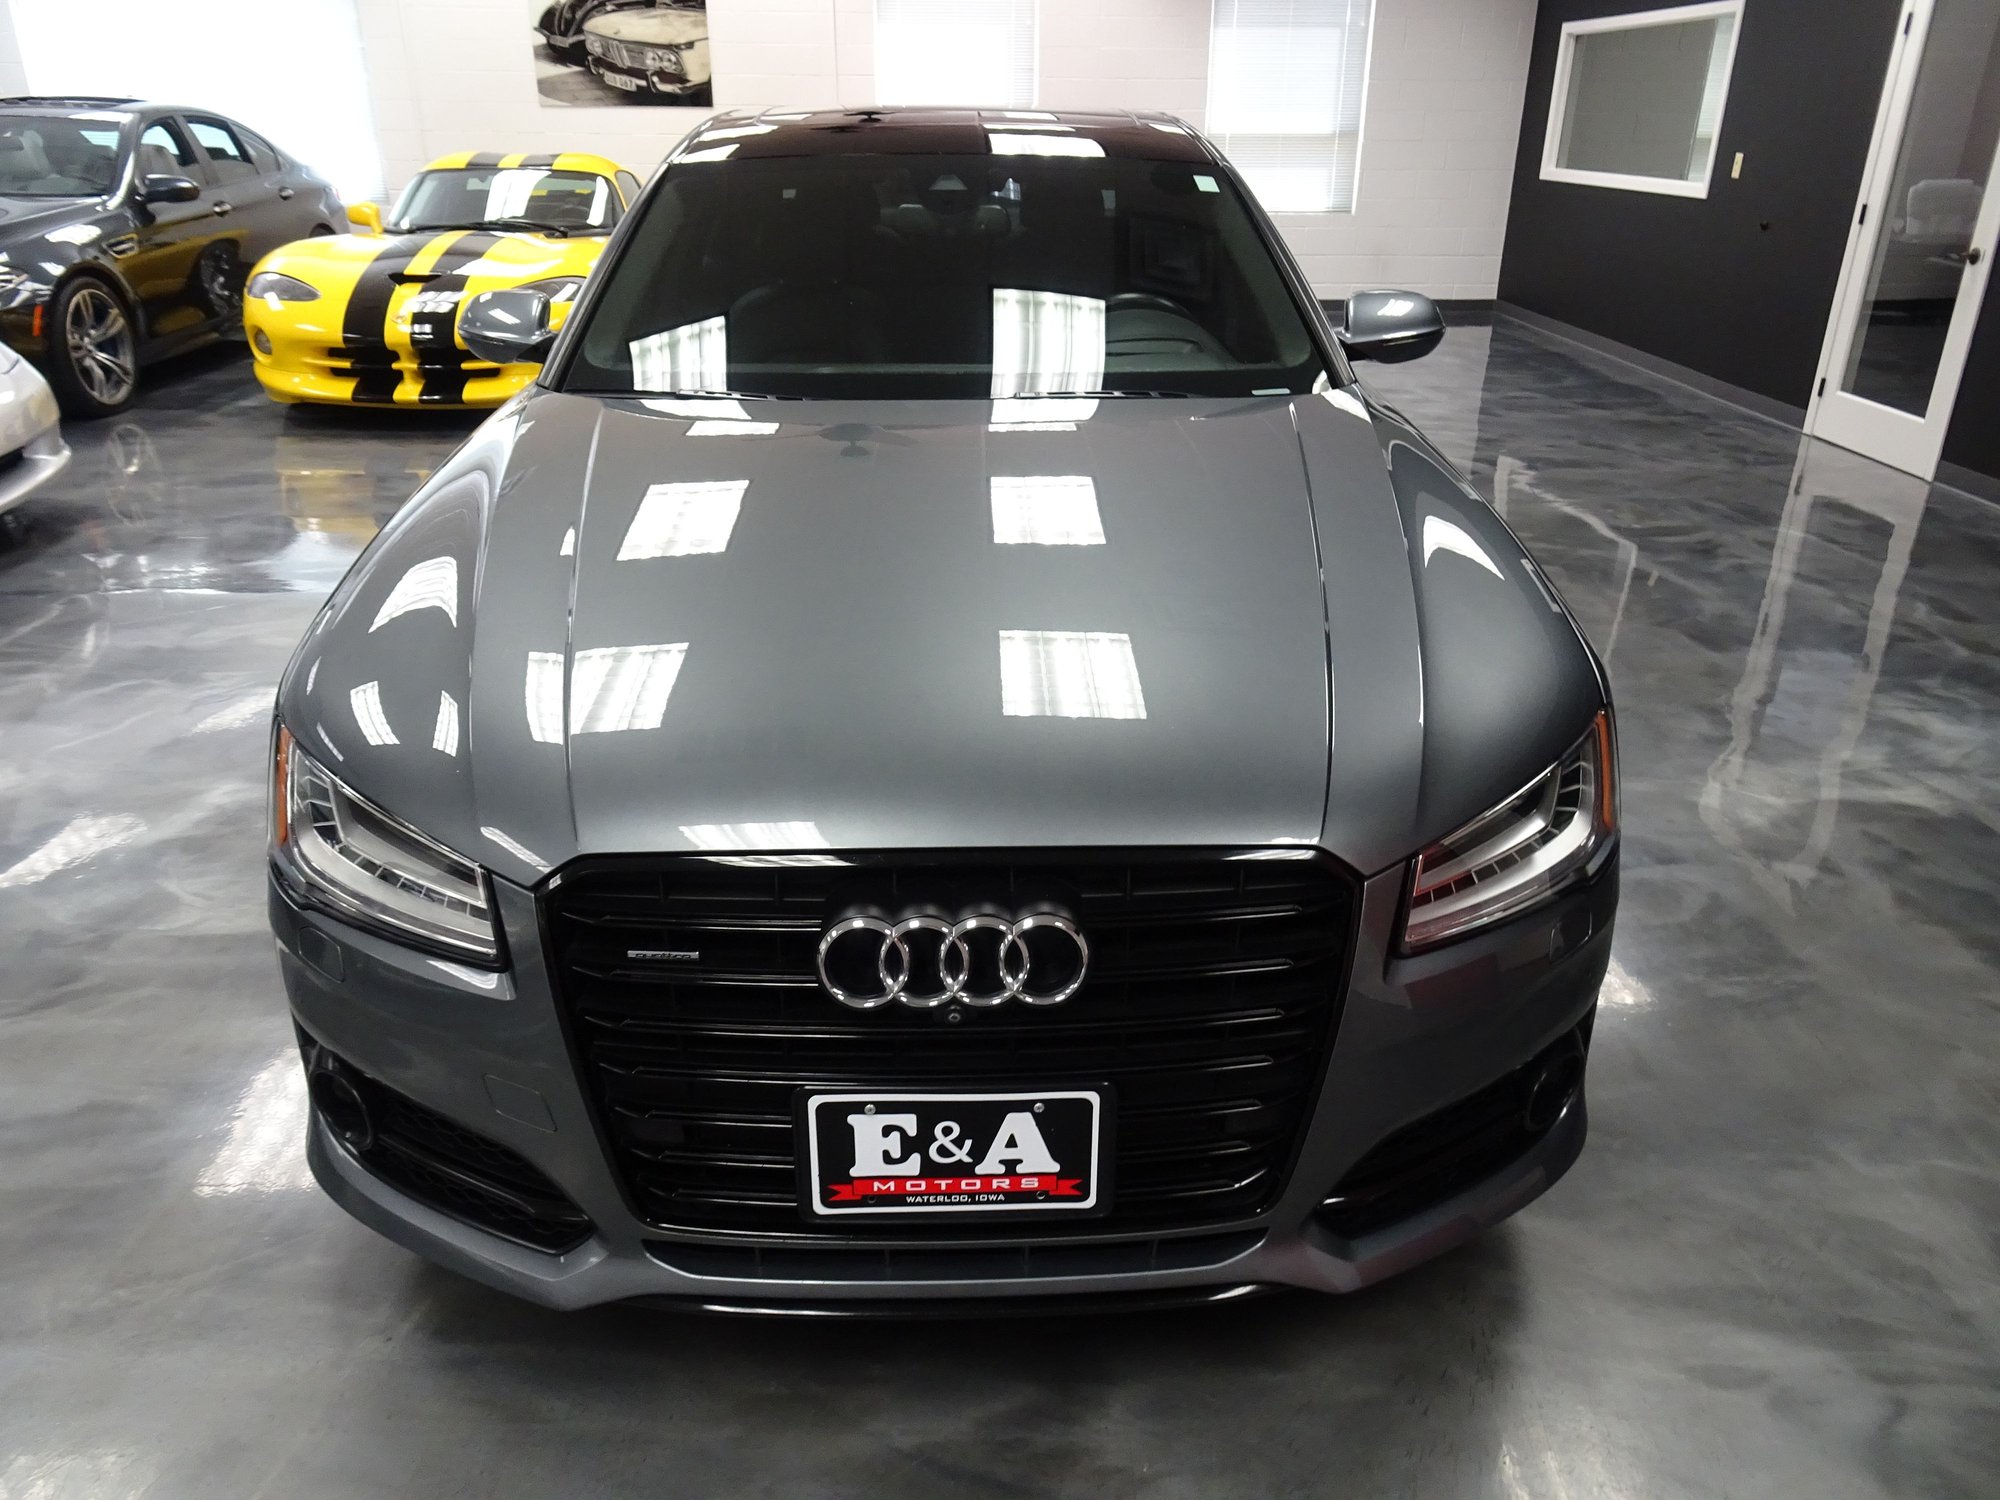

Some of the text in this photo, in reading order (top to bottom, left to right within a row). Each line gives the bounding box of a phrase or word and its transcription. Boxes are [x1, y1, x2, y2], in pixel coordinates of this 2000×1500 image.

[873, 1178, 1039, 1192] MOTORS
[906, 1194, 1005, 1203] WATERLOO, IOWA
